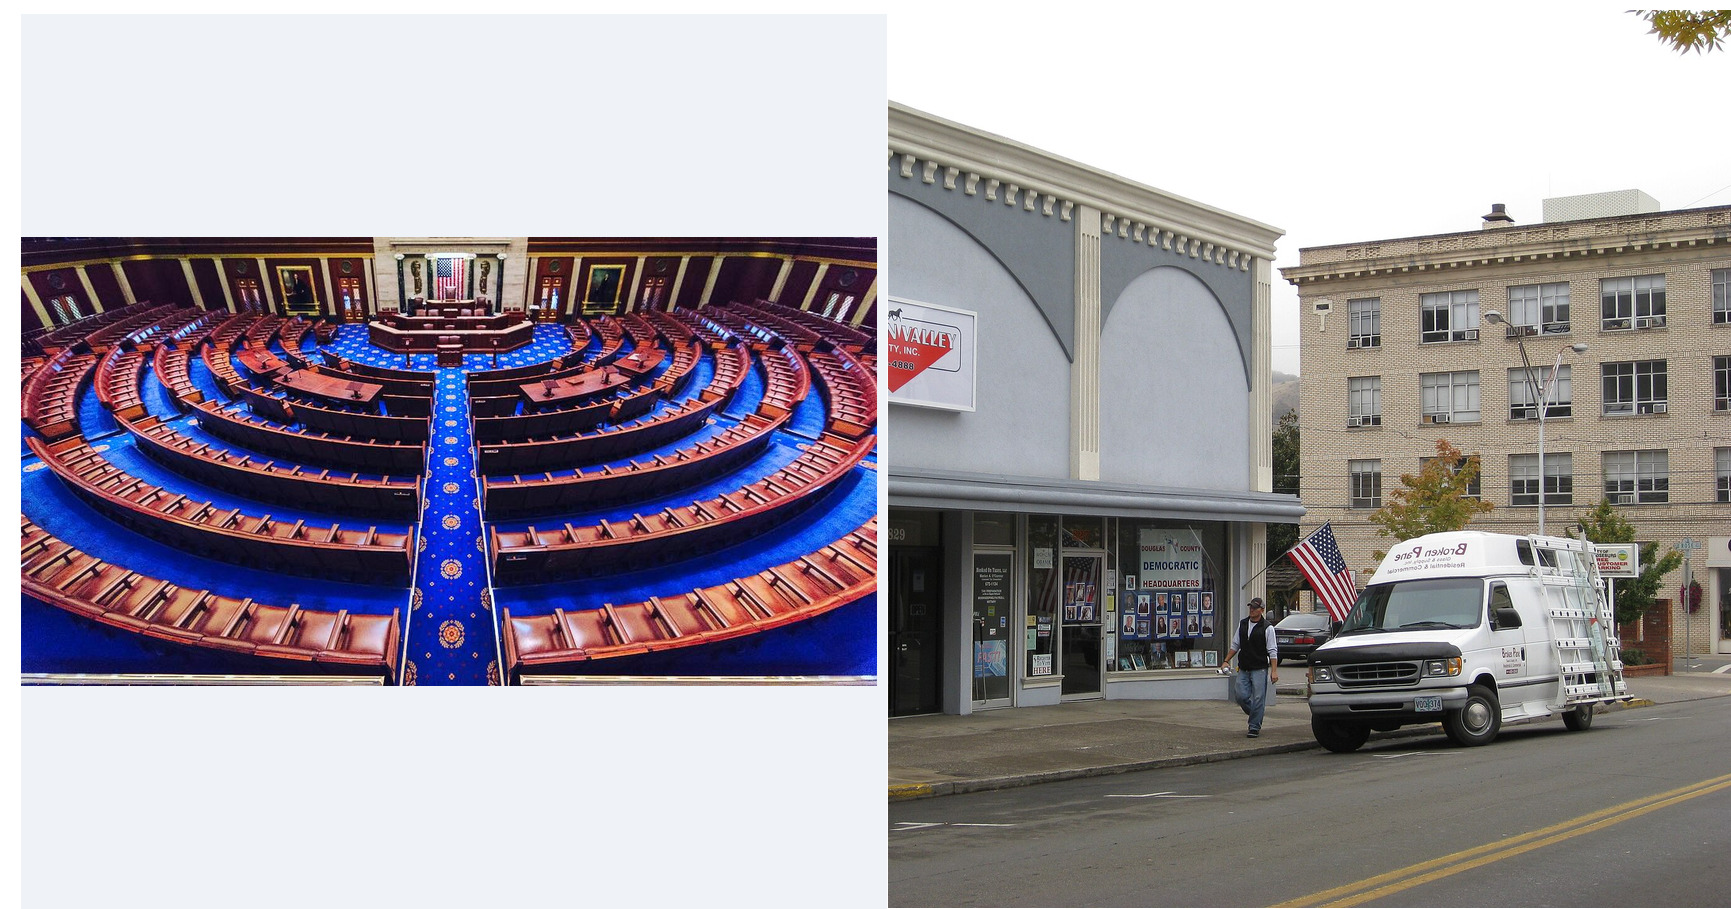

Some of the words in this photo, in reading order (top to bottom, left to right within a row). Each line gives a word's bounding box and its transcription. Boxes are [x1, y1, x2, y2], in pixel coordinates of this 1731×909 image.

[901, 325, 957, 350] VALLEY
[888, 343, 902, 354] TY,
[903, 347, 920, 357] INC.
[888, 360, 915, 371] -4888
[1143, 561, 1199, 571] DEMOCRATIC
[1143, 580, 1200, 588] HEADQUARTERS
[1034, 666, 1051, 675] HERE
